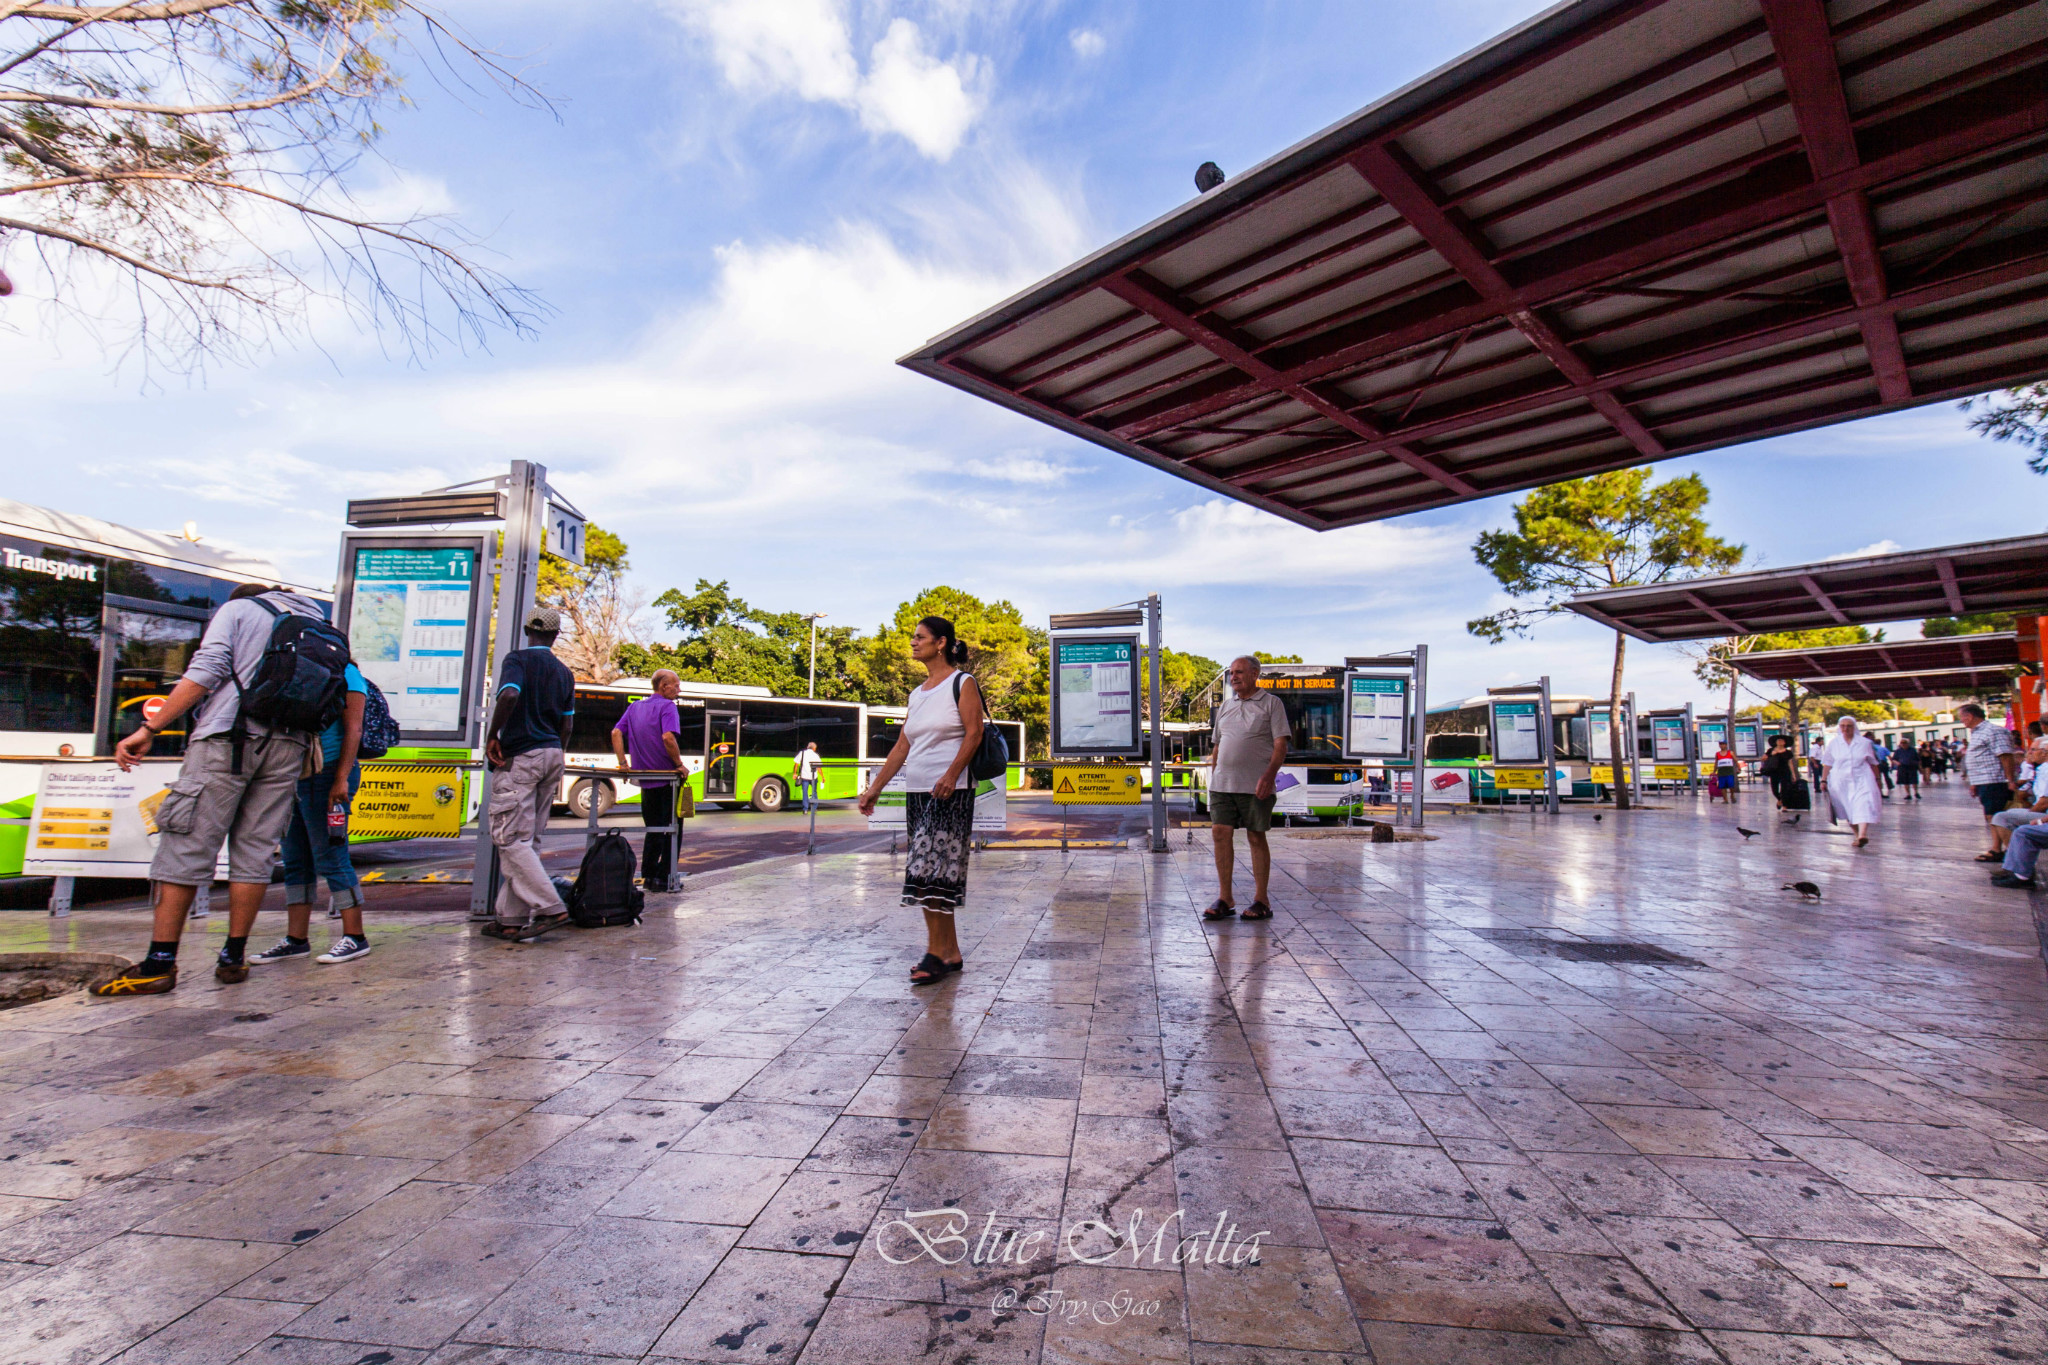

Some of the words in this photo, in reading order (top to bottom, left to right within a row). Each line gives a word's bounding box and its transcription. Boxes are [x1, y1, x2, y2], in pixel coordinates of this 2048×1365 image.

[556, 519, 577, 555] 11
[3, 547, 97, 582] Transport
[448, 560, 468, 576] 11
[1115, 649, 1128, 659] 10
[1255, 679, 1275, 688] ORRY
[1276, 679, 1291, 688] NOT
[1293, 679, 1302, 688] IN
[1304, 679, 1335, 688] SERVICE
[1394, 684, 1400, 692] 9
[678, 698, 705, 707] Transport
[360, 781, 404, 790] ATTENT!
[384, 790, 418, 798] il-bankina
[358, 802, 410, 812] CAUTION!
[357, 811, 373, 820] Stay
[385, 811, 396, 819] the
[397, 812, 435, 820] pavement
